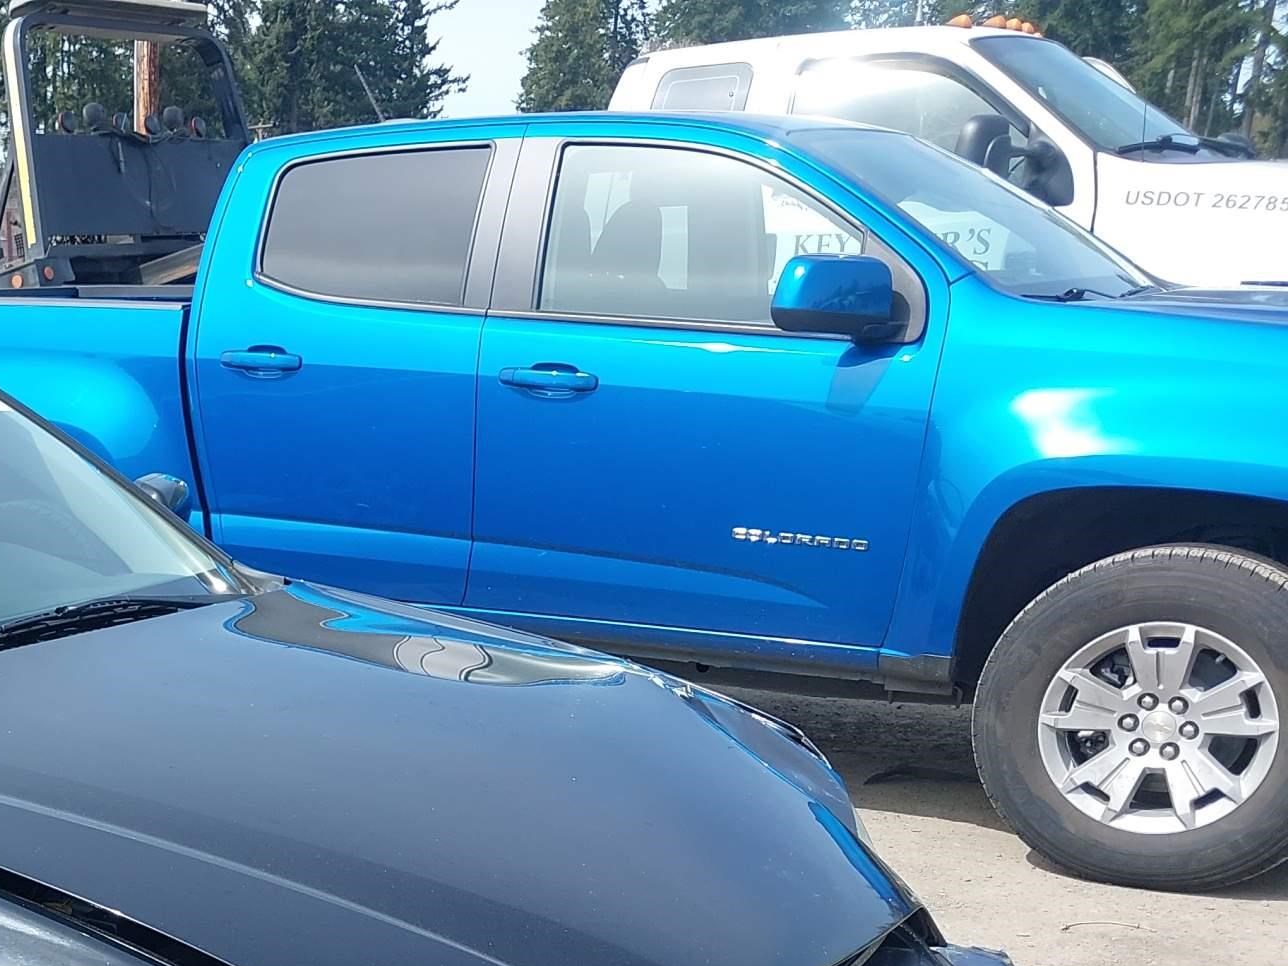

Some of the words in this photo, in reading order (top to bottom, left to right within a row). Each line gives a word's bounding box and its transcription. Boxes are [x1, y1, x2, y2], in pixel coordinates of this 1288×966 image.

[1125, 190, 1206, 208] USDOT
[793, 234, 854, 256] KEY
[732, 527, 869, 550] COLORADO
